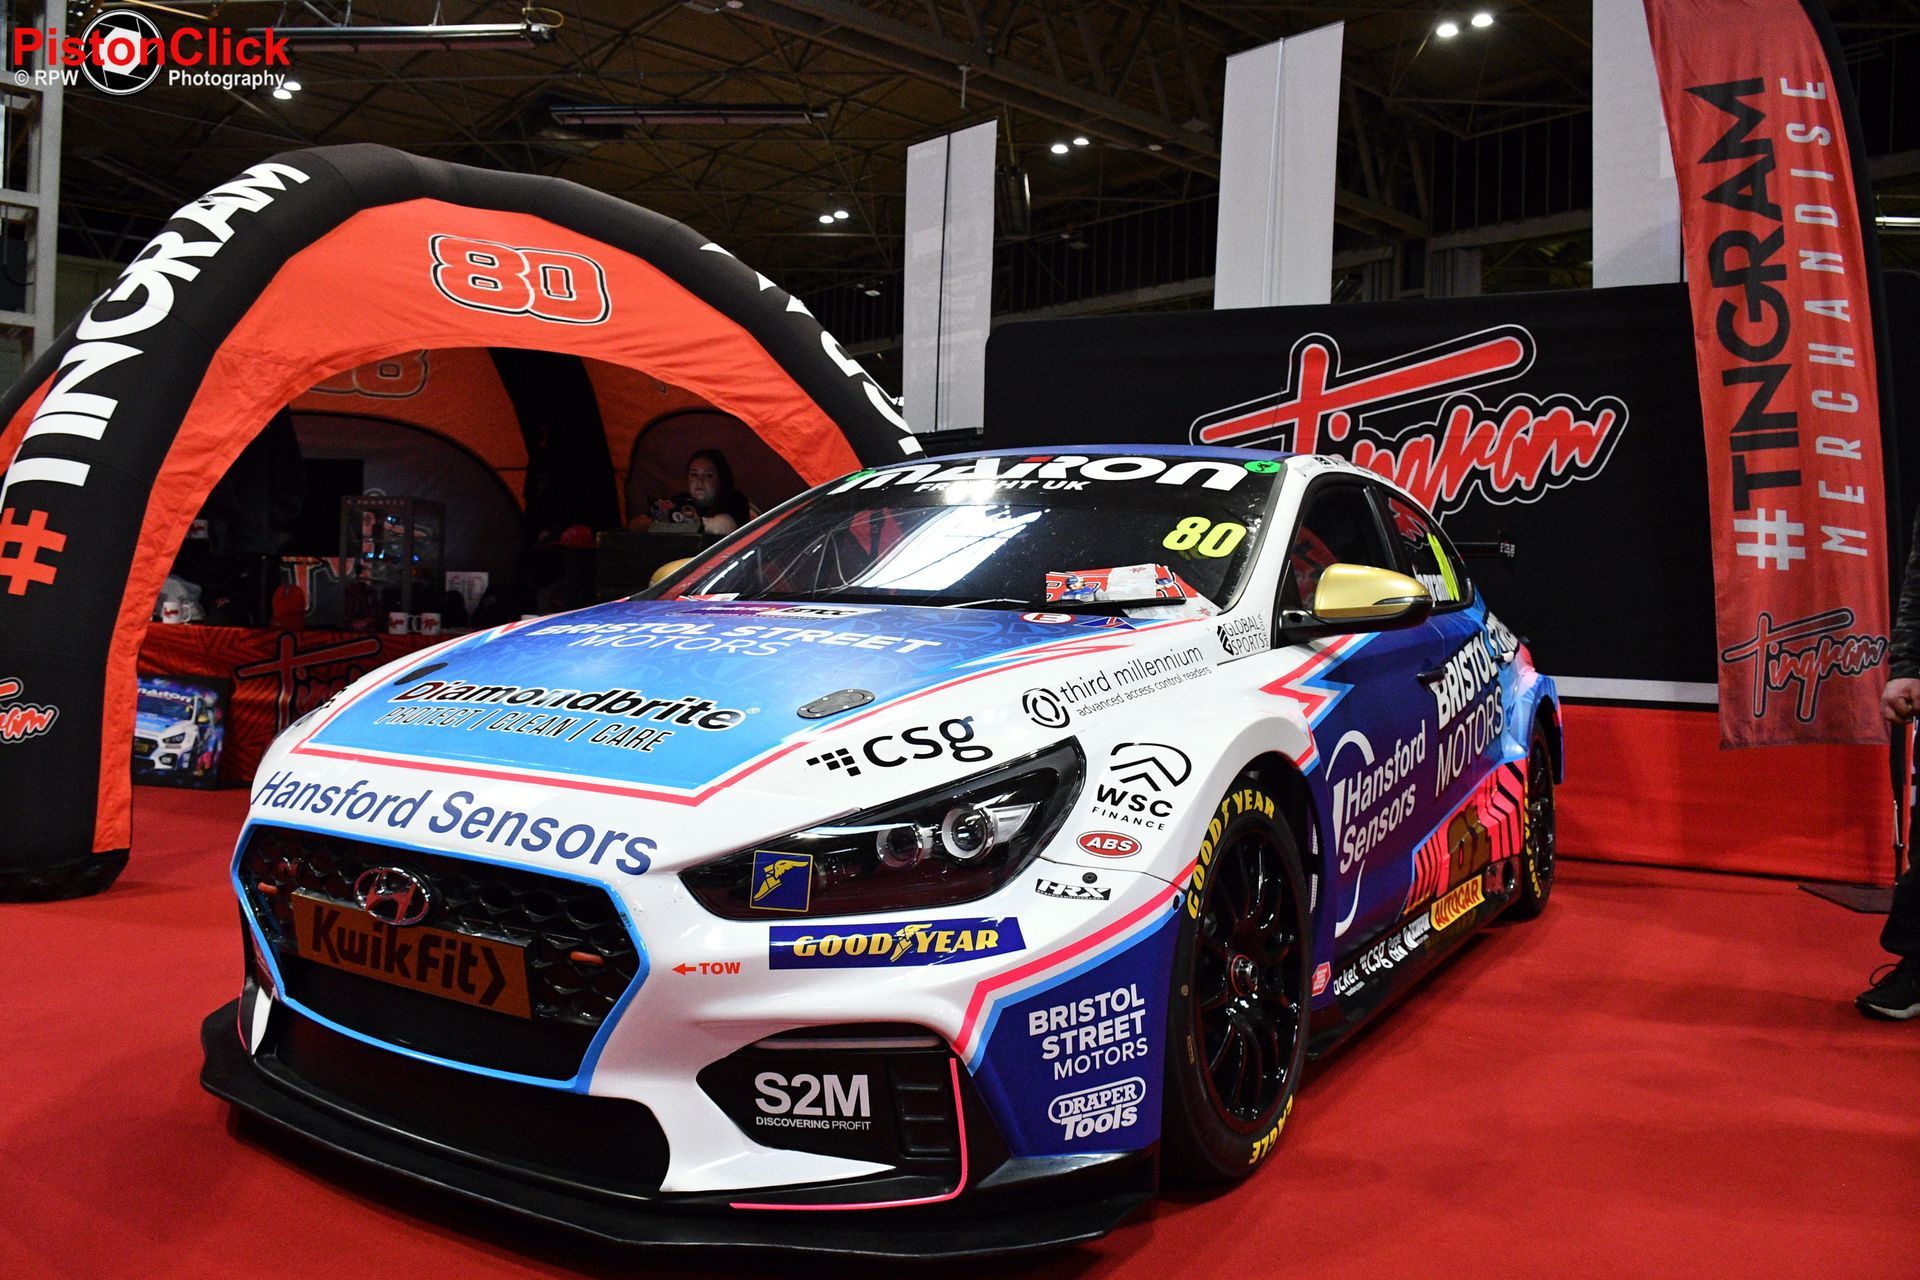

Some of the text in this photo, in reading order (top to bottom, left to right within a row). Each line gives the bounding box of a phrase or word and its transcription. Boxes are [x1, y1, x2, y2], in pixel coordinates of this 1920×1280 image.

[429, 234, 612, 326] 80
[1780, 77, 1868, 557] MERCHANDISE
[1194, 329, 1623, 520] Tngram
[1042, 480, 1091, 491] UK
[1162, 516, 1246, 558] 80
[526, 623, 942, 654] BRISTOL STREET
[568, 634, 791, 656] MOTORS
[1223, 616, 1260, 637] GLOBAL
[1231, 633, 1266, 656] SPORTS
[1060, 647, 1204, 704] third millennium
[1076, 693, 1125, 717] advanced
[1125, 685, 1156, 701] access
[1154, 674, 1184, 690] control
[1429, 632, 1498, 731] BRISTOL
[375, 706, 672, 753] PROTECT CLEAN CARE
[1436, 686, 1504, 798] MOTORS
[1345, 719, 1426, 825] Hansford
[250, 770, 658, 876] Hansford Sensors
[1092, 806, 1165, 831] FINANCE
[1097, 784, 1174, 818] WSC
[1086, 836, 1133, 852] ABS
[1340, 783, 1417, 874] Sensors
[1435, 879, 1481, 928] AUTOCAR
[699, 962, 741, 976] TOW
[1029, 983, 1145, 1036] BRISTOL
[1042, 1009, 1146, 1060] STREET
[1054, 1037, 1148, 1080] MOTORS
[754, 1071, 871, 1117] S2M
[1058, 1083, 1137, 1118] DRAPER
[755, 1116, 871, 1131] DISCOVERING PROFIT
